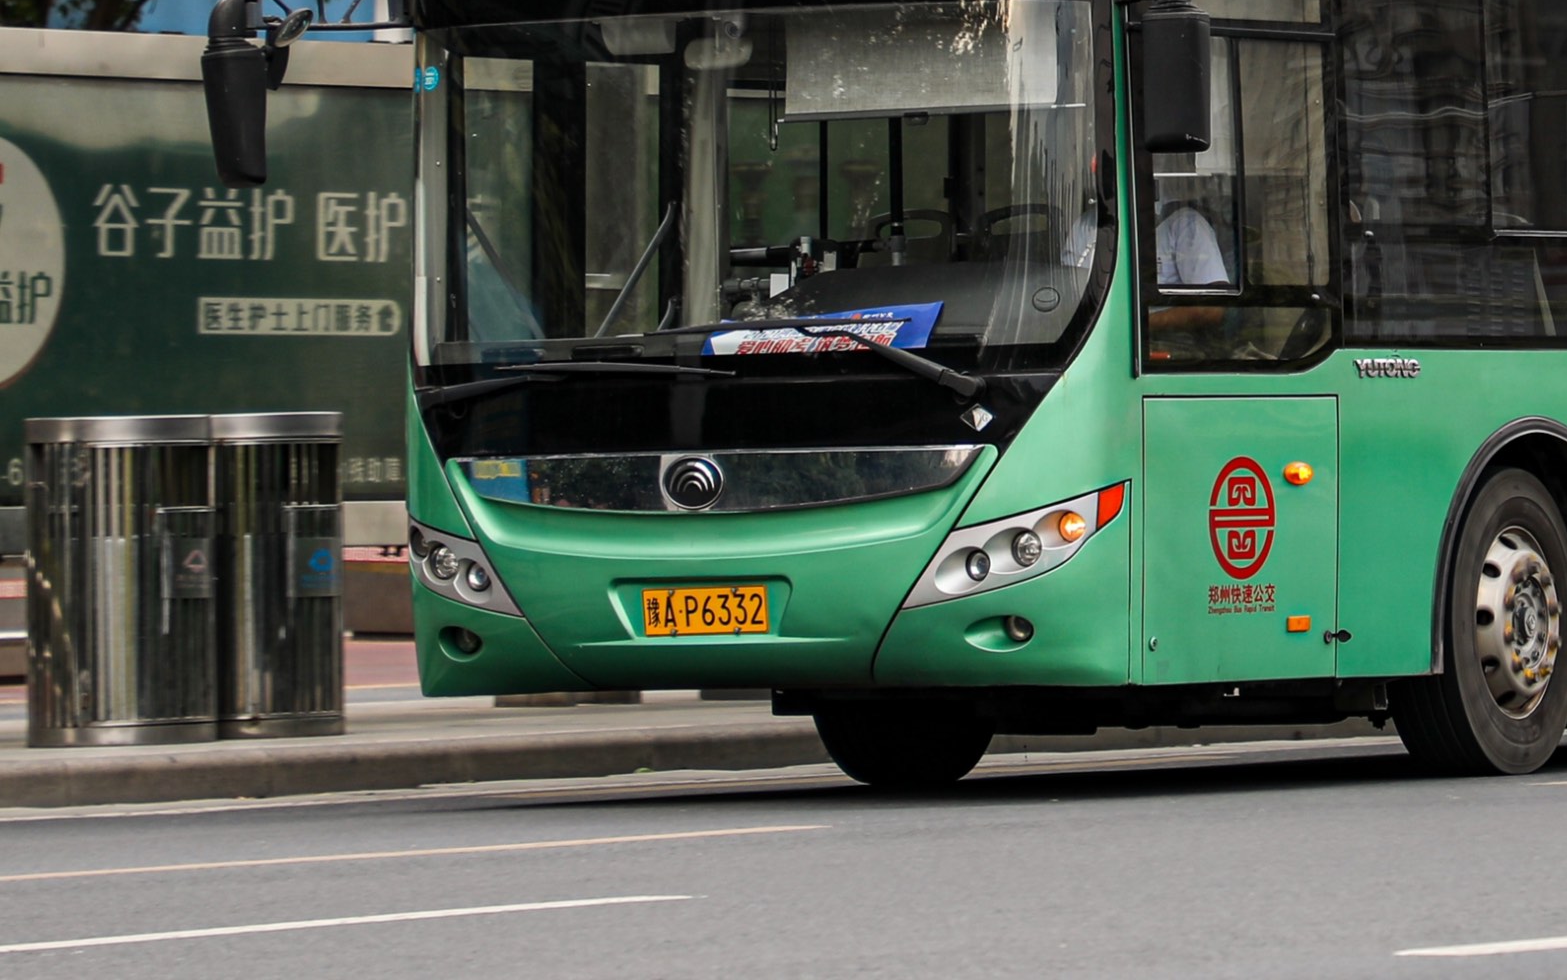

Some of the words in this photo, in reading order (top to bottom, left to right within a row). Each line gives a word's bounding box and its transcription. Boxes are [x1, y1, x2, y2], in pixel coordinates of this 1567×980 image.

[92, 183, 295, 260] 谷子益护
[315, 191, 407, 263] 医护
[1353, 358, 1421, 378] YUTONG
[1208, 583, 1275, 604] 郑州快速公交
